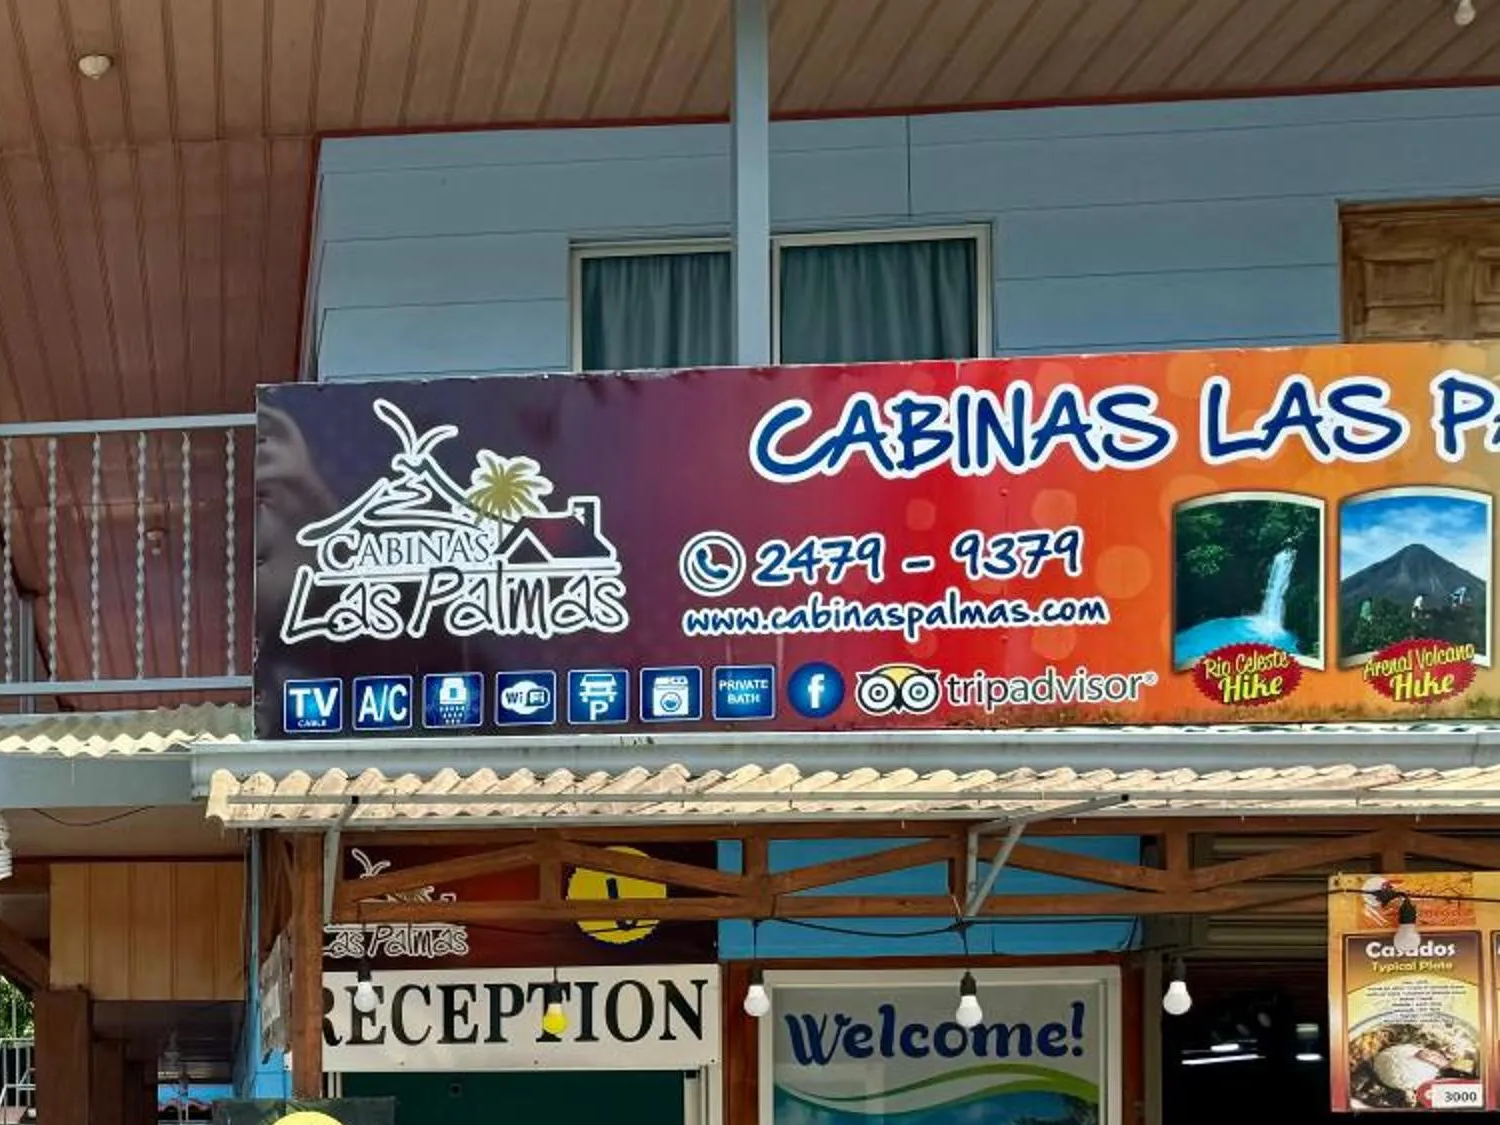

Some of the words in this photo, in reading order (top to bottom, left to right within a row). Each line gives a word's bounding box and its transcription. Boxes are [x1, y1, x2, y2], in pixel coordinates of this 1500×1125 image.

[750, 380, 1177, 483] CABINAS
[1205, 374, 1410, 465] LAS
[1431, 369, 1500, 462] P
[325, 533, 490, 572] CABINAS
[753, 533, 884, 588] 2479
[951, 526, 1083, 577] 9379
[282, 566, 402, 643] Las
[408, 562, 629, 640] Palmas
[683, 588, 1109, 643] www.cabinaspalmas.com
[1235, 651, 1289, 675] Celeste
[1363, 656, 1413, 681] Arenal
[1417, 643, 1476, 671] Volcano
[719, 679, 769, 691] PRIVATE
[727, 694, 760, 705] BATH
[1220, 673, 1284, 704] Hike
[1391, 671, 1455, 702] Hike
[288, 687, 338, 718] TV
[358, 684, 407, 723] A/C
[590, 701, 609, 720] P
[322, 930, 365, 958] as
[367, 925, 469, 958] Palmas
[1372, 960, 1417, 973] Typical
[1420, 961, 1453, 971] Plate
[783, 1001, 1086, 1067] Welcome!
[1444, 1090, 1477, 1104] 3000
